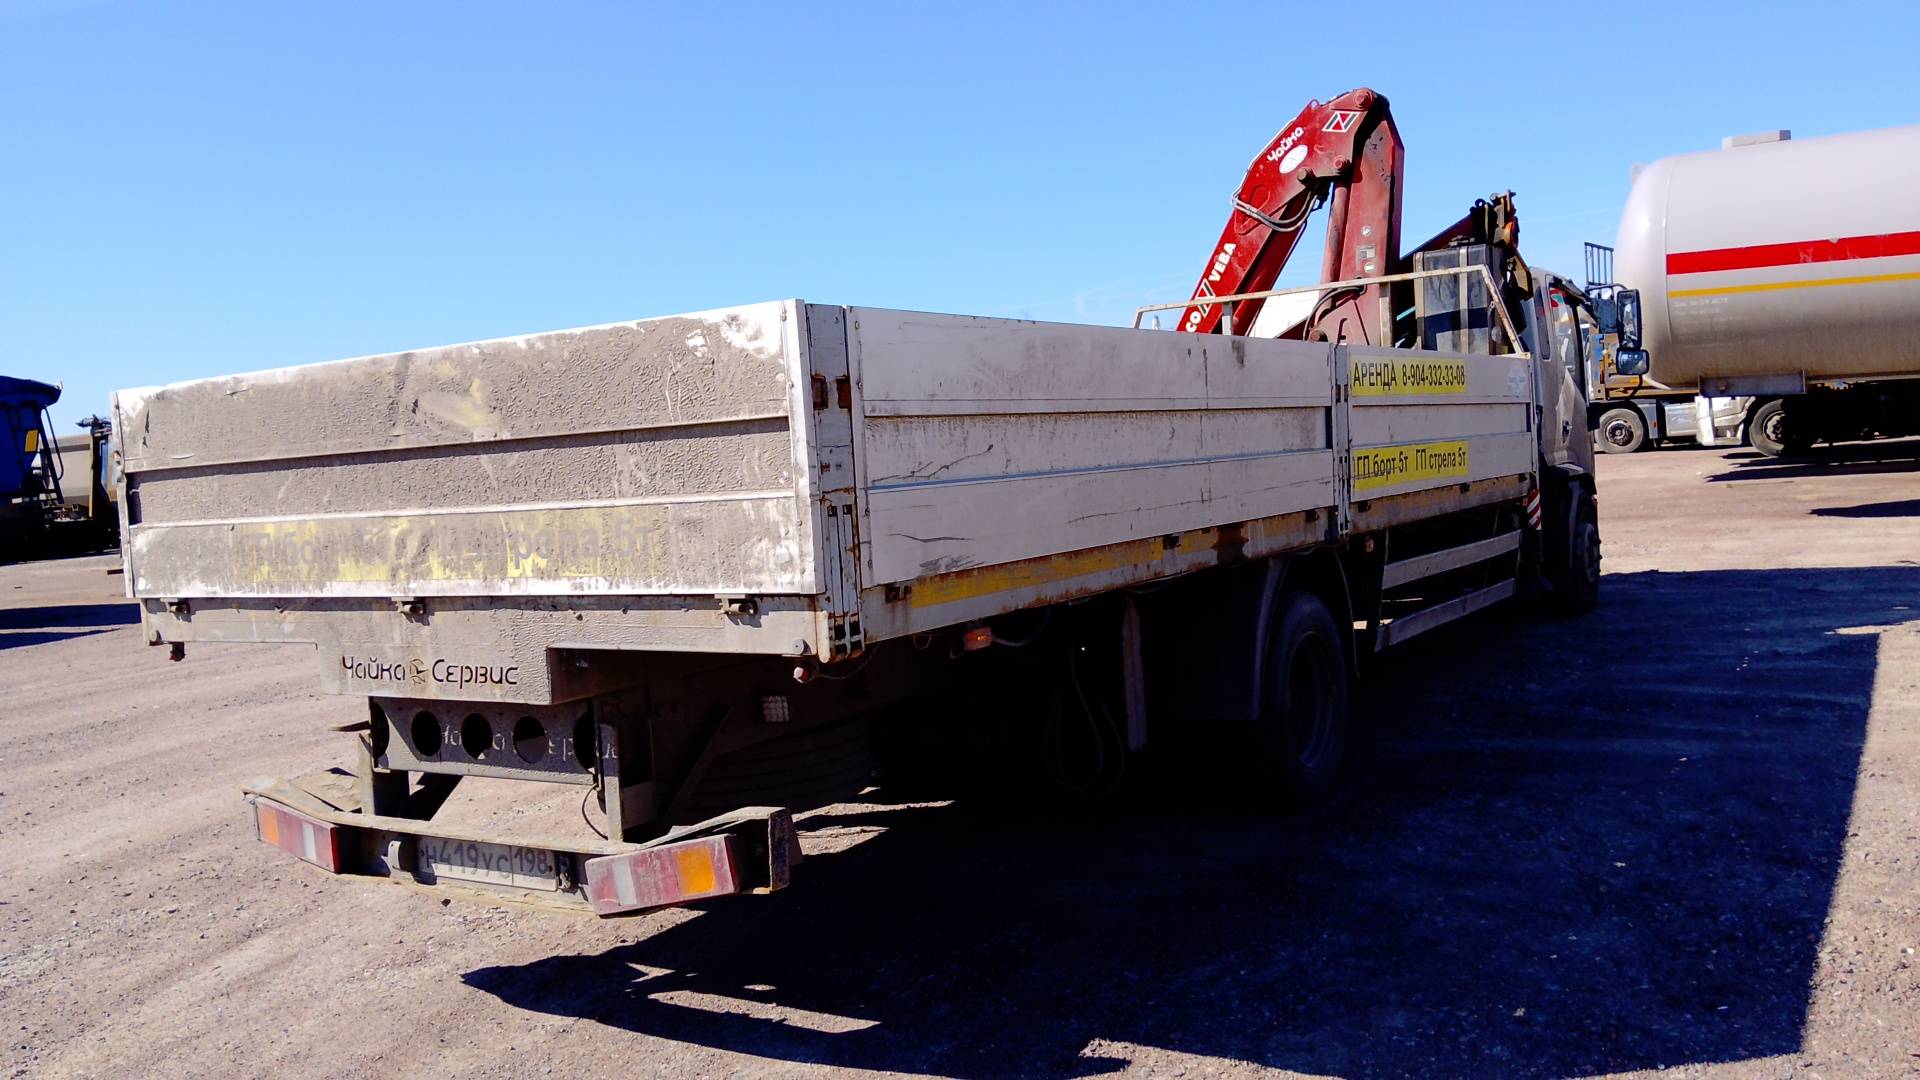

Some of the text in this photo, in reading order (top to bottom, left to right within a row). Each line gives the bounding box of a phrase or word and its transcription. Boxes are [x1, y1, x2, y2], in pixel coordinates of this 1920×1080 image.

[1208, 243, 1237, 281] VEBA
[1353, 360, 1466, 392] АРЕНДА 8-904-332-33-08
[1373, 453, 1397, 481] борт
[1415, 448, 1427, 471] ГП
[1429, 451, 1457, 474] стрела
[342, 656, 519, 690] Чайка Сервис
